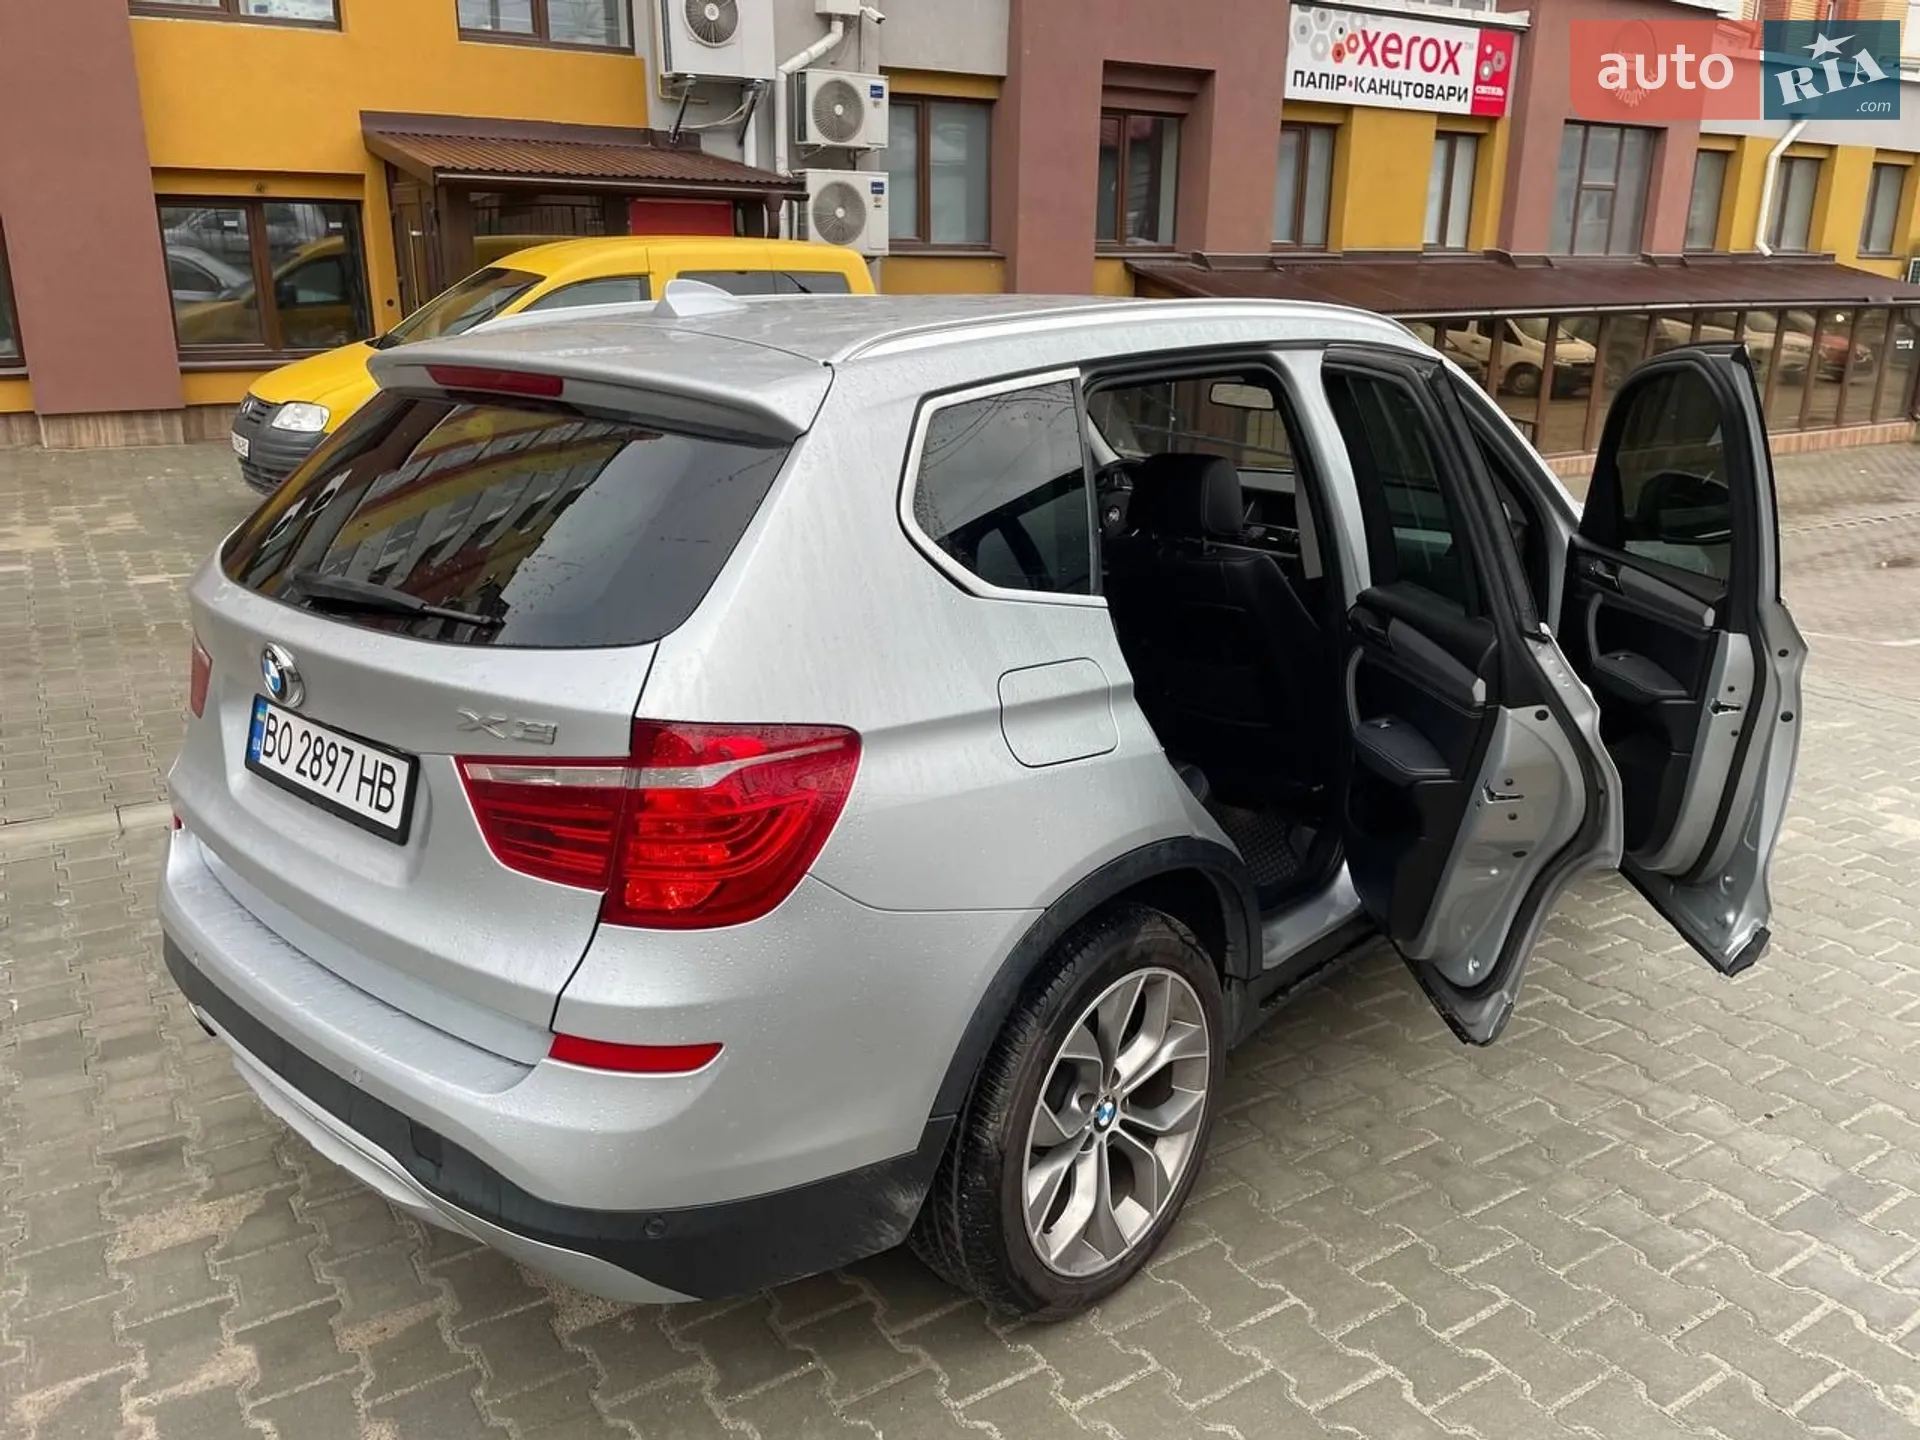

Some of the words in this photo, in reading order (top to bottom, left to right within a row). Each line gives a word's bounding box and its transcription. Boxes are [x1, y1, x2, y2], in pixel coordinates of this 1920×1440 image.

[1357, 29, 1463, 76] xerox
[1293, 70, 1347, 92] ПАПІР
[1354, 76, 1469, 103] КАНЦТОВАРИ
[456, 707, 558, 745] X3
[263, 712, 293, 765] BO
[295, 730, 354, 793] 2897
[355, 754, 397, 813] HB
